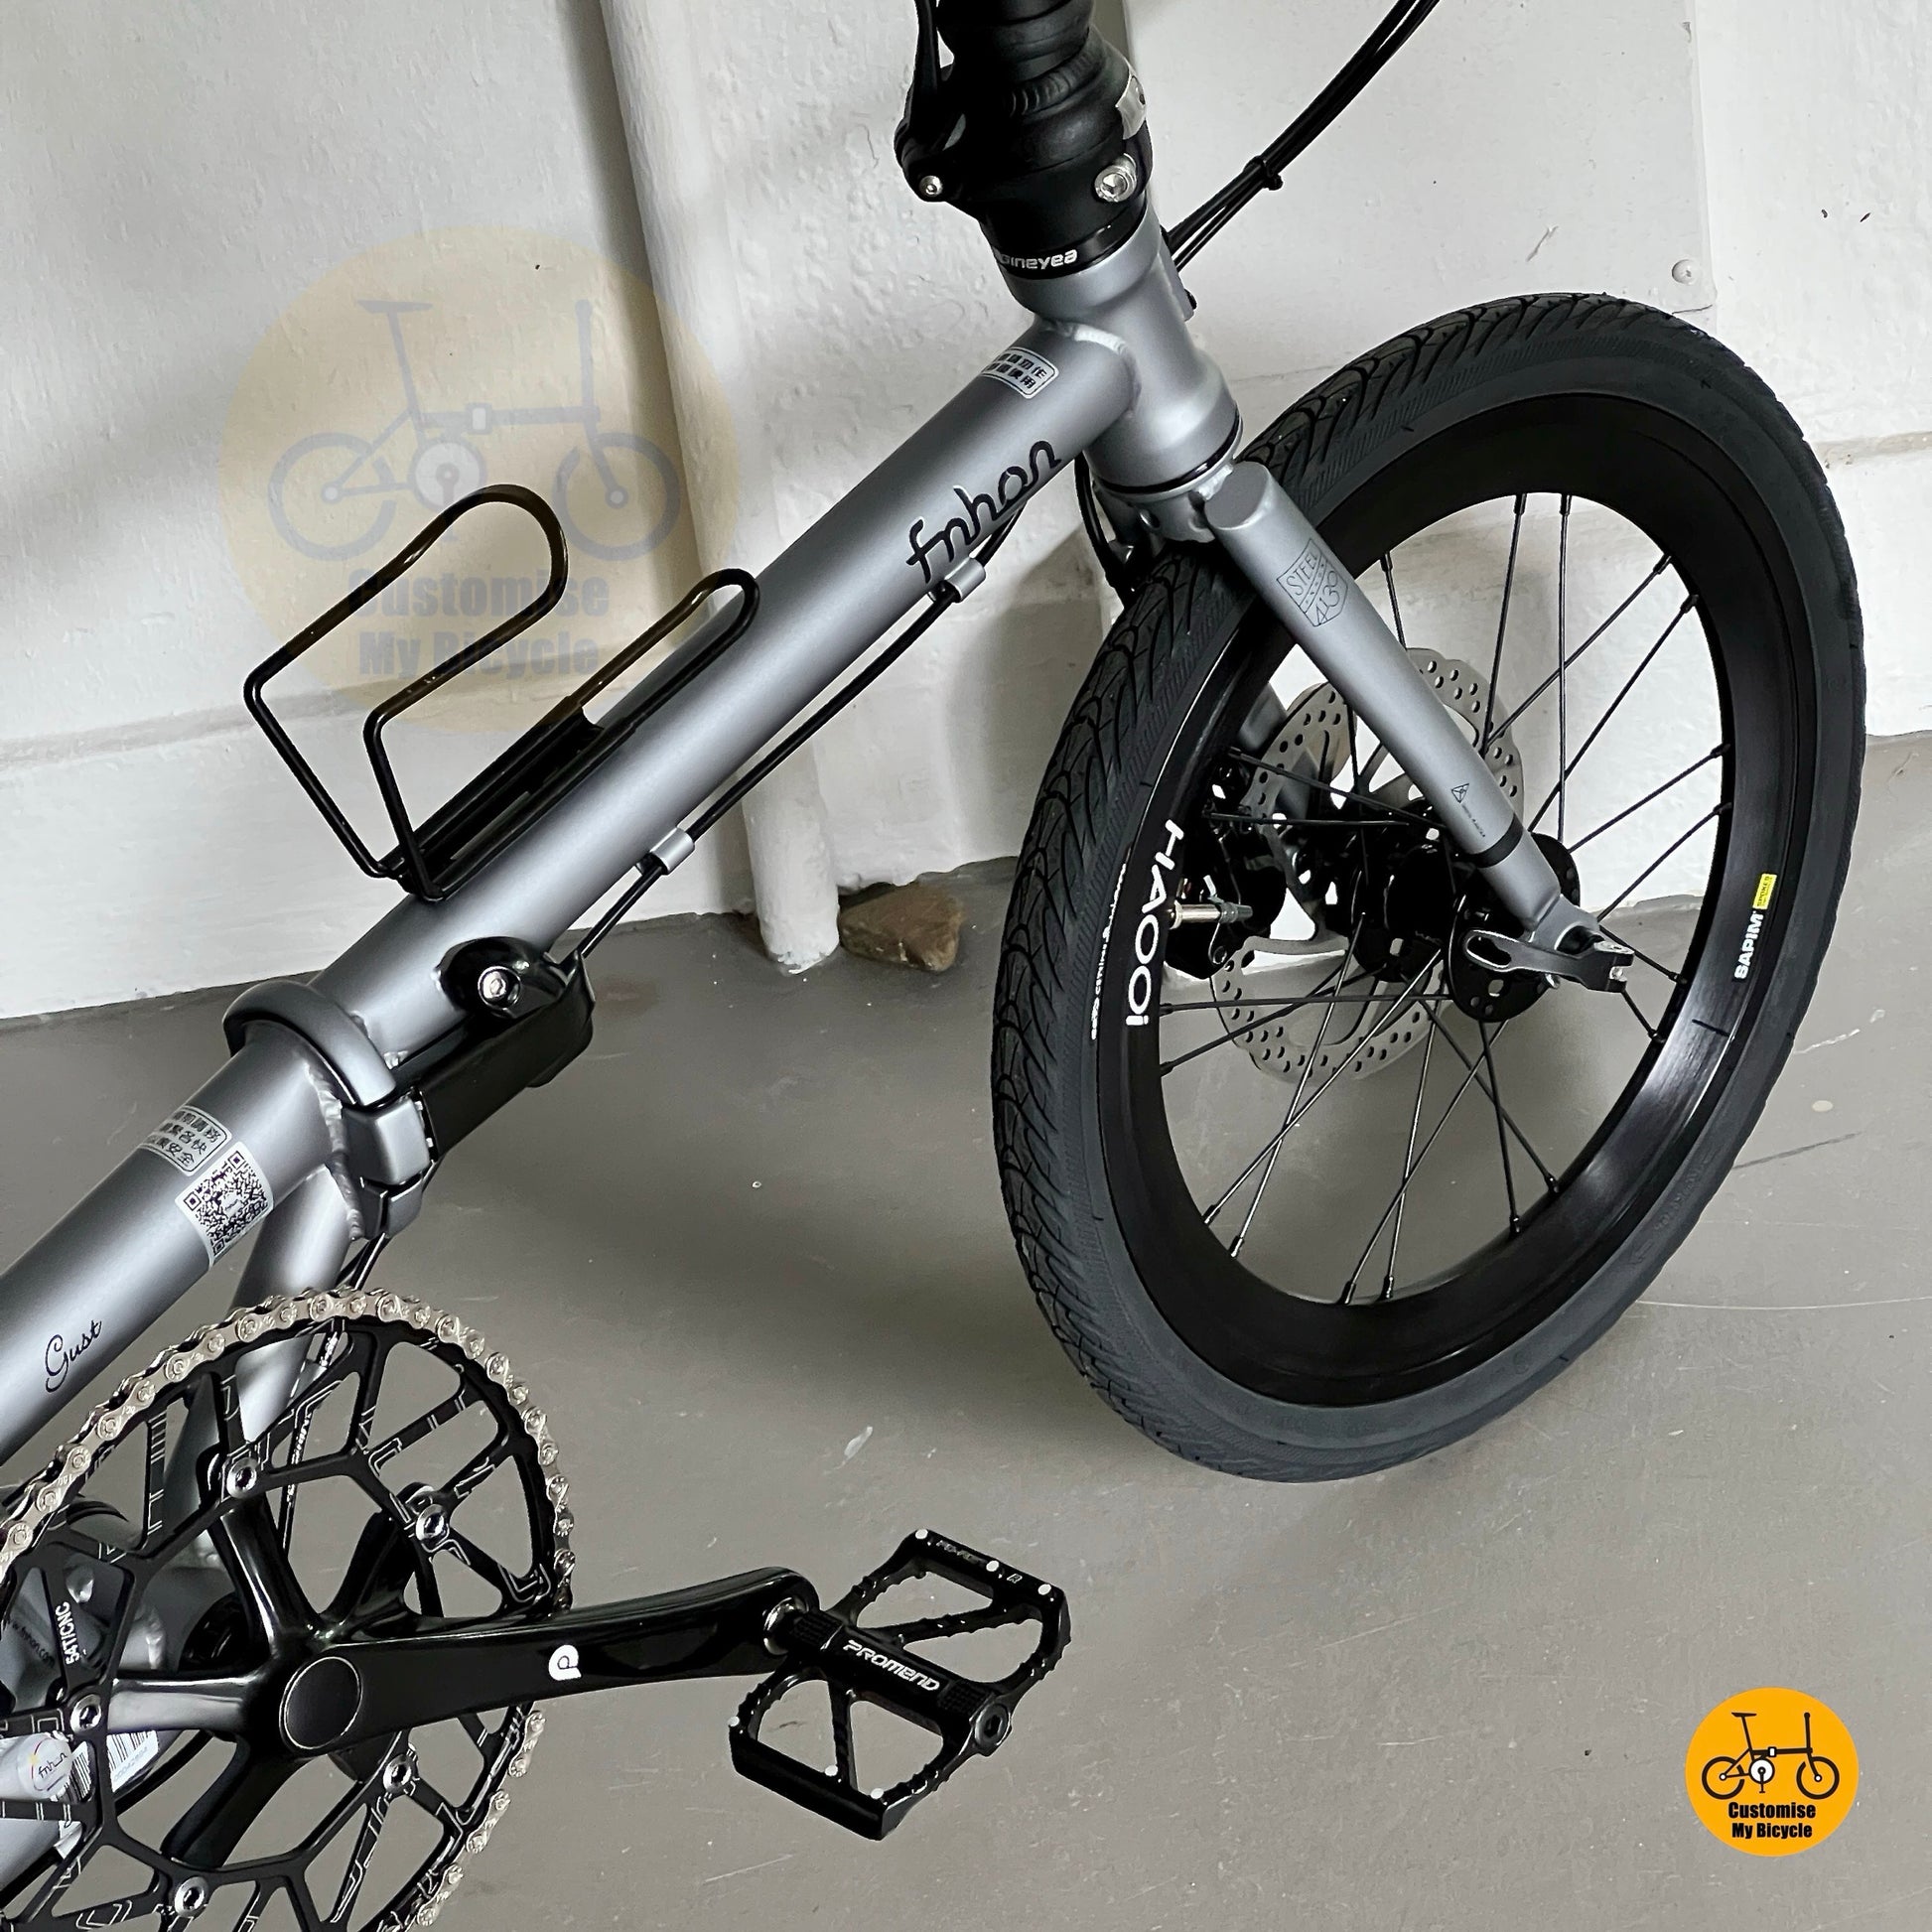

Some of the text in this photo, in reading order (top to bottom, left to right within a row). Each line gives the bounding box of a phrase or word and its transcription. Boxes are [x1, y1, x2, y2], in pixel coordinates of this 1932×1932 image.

[906, 440, 1061, 584] fnhon
[1734, 913, 1764, 979] SAPIM
[45, 1319, 102, 1392] Gust
[843, 1639, 940, 1692] PROMEND
